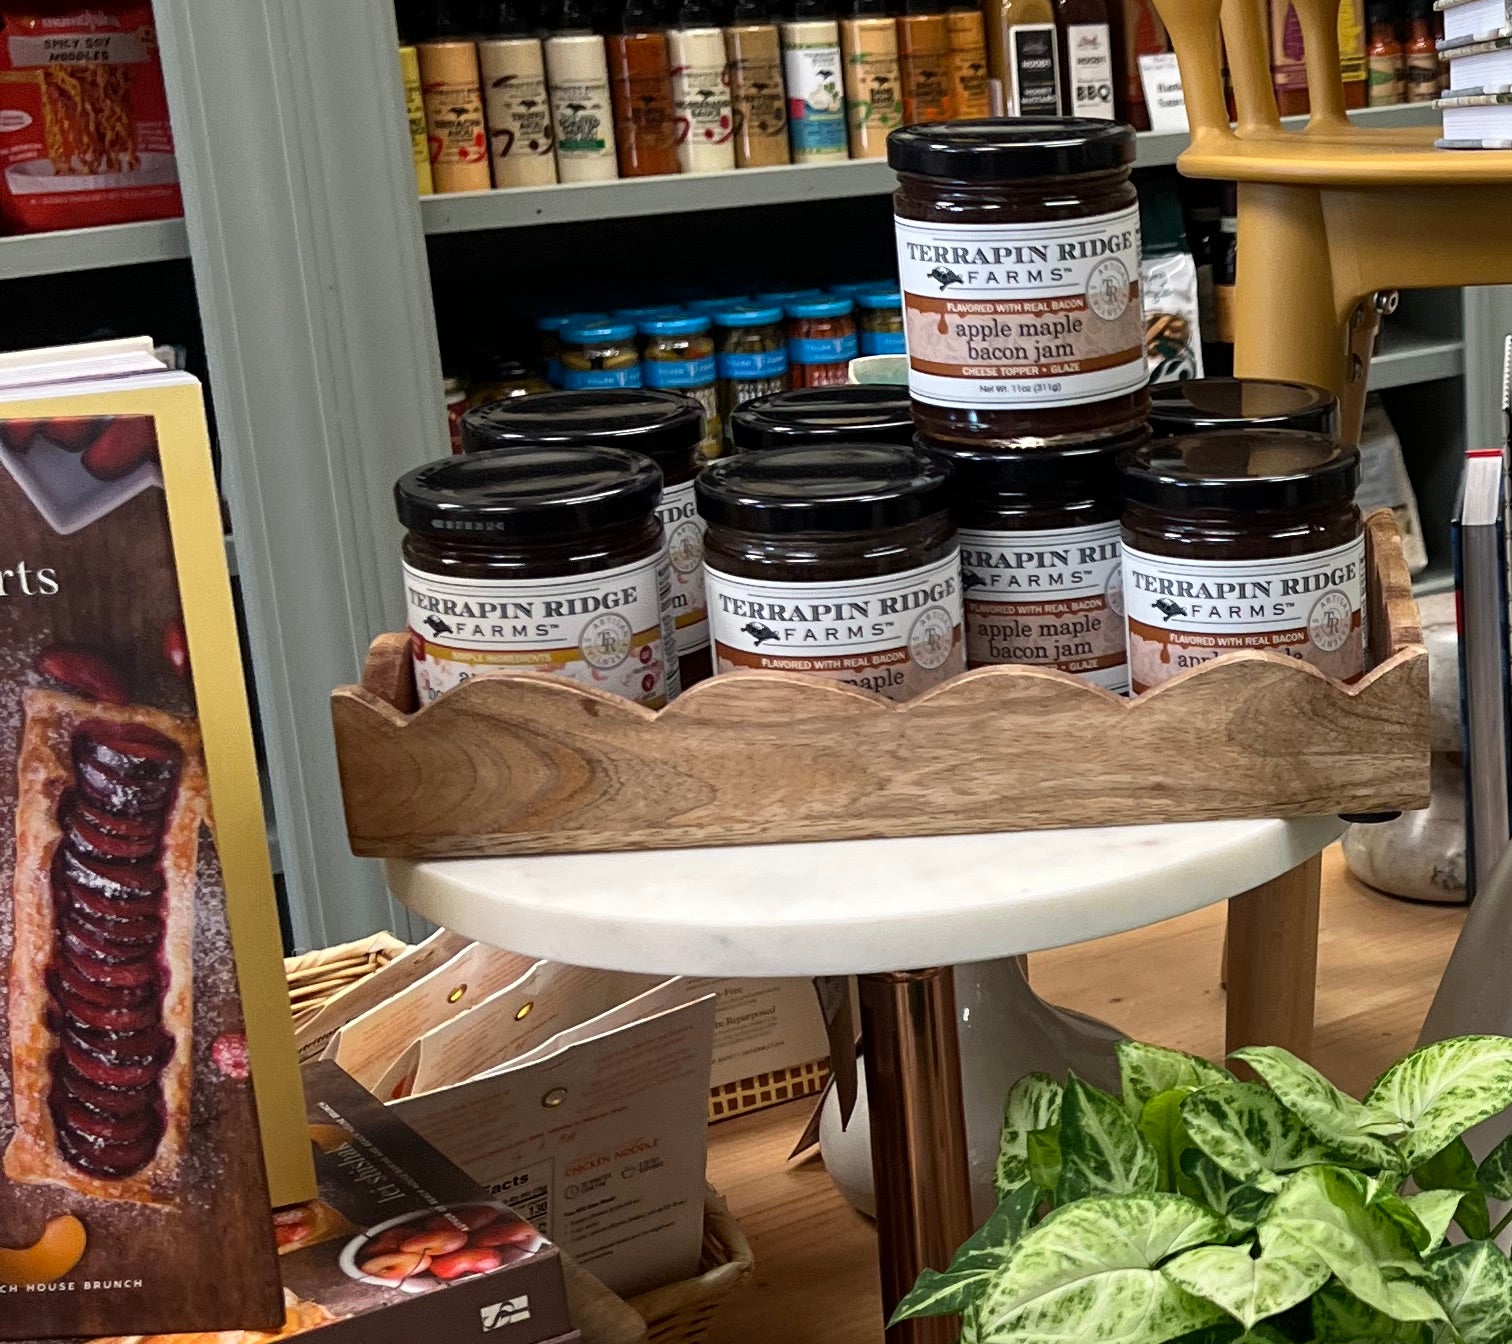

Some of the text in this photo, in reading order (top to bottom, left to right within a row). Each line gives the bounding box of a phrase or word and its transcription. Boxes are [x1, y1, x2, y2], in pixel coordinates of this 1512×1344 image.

[44, 38, 80, 50] SPICY
[1076, 84, 1111, 104] BBQ
[906, 231, 1133, 265] TERRAPIN RIDGE
[946, 299, 1084, 313] FLAVORED WITH REAL BACON
[956, 314, 1083, 342] apple maple
[967, 340, 1075, 364] bacon jam
[962, 362, 1081, 377] CHEESE TOPPER GLAZE
[979, 385, 995, 393] Net
[961, 548, 1070, 570] RRAPIN
[1132, 561, 1357, 600] TERRAPIN RIDGE
[409, 585, 638, 619] TERRAPIN RIDGE
[719, 577, 956, 622] TERRAPIN RIDGE
[970, 599, 1103, 615] FLAVORED WITH REAL BACON
[978, 615, 1102, 644] apple maple
[1169, 631, 1305, 647] FLAVORED WITH REAL BACON
[762, 651, 906, 670] FLAVORED WITH REAL BACON
[989, 639, 1093, 664] bacon jam
[26, 1280, 77, 1293] HOUSE
[83, 1278, 144, 1292] BRUNCH
